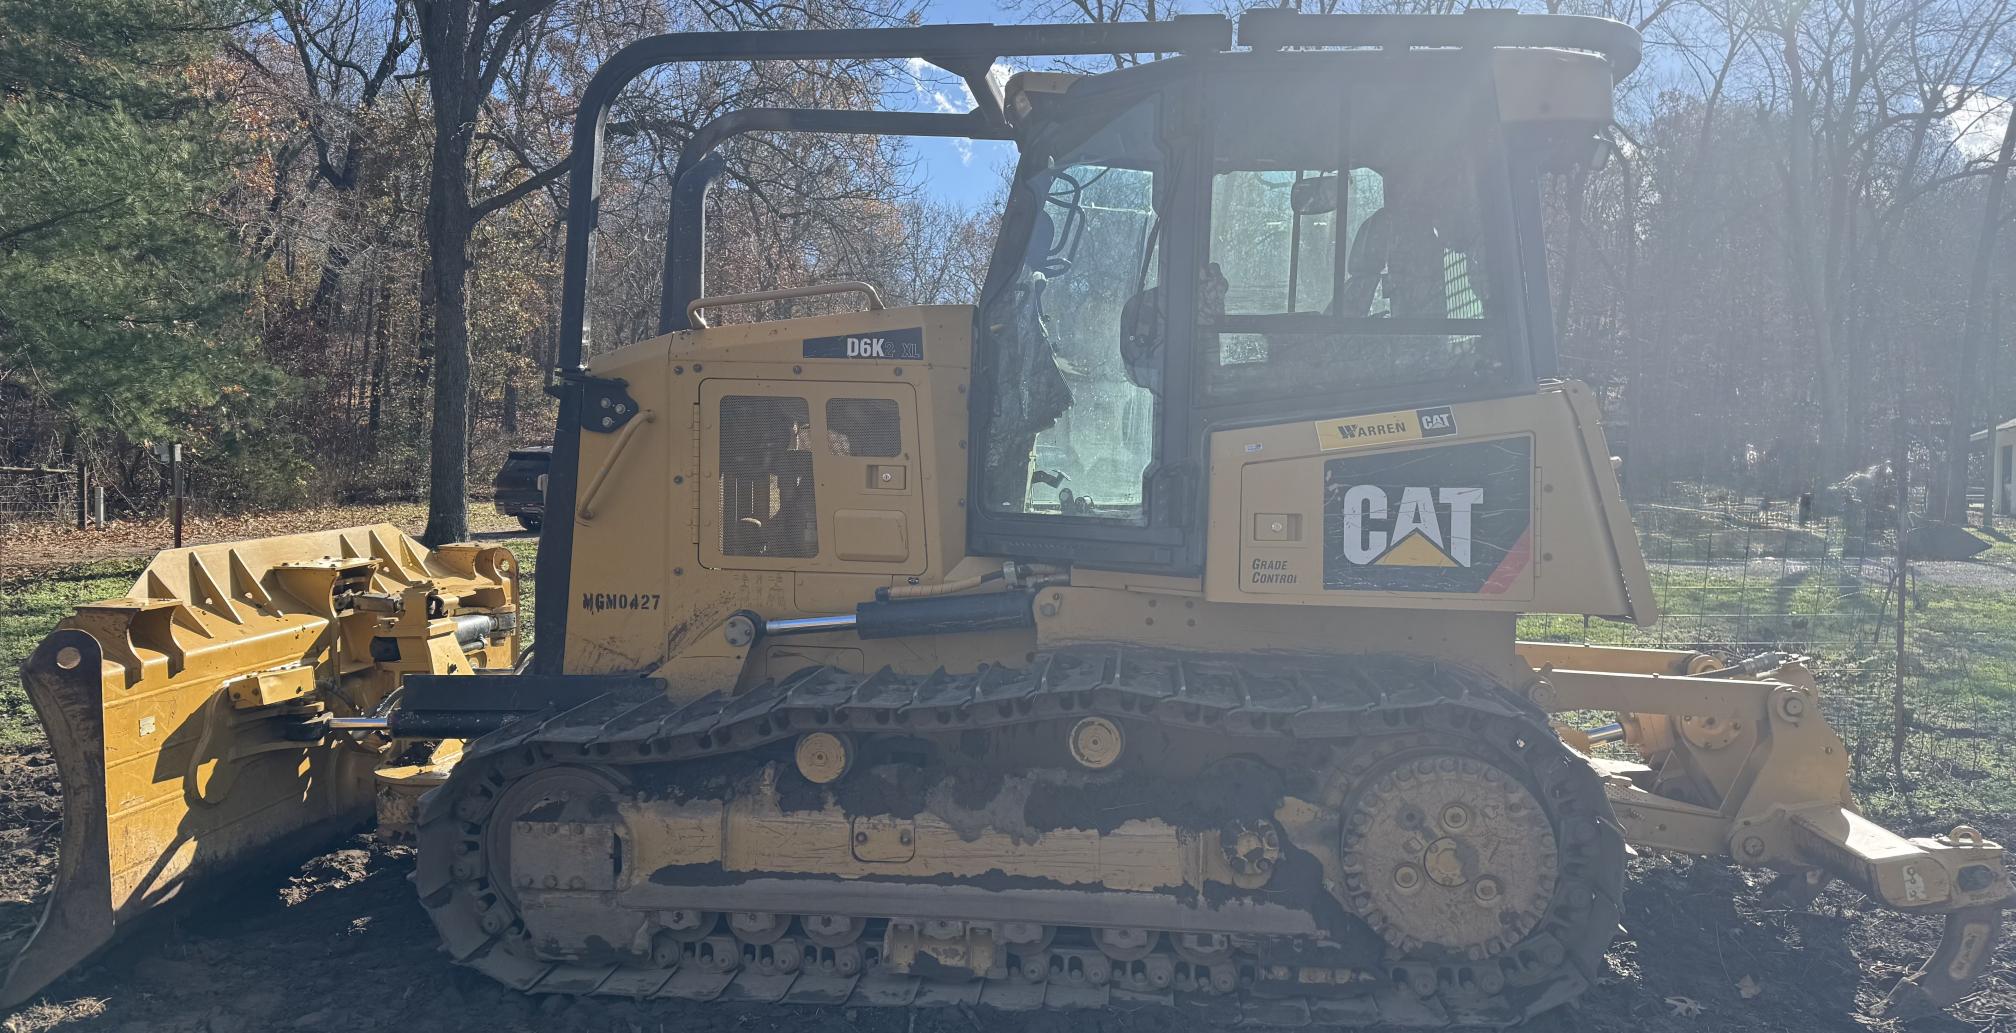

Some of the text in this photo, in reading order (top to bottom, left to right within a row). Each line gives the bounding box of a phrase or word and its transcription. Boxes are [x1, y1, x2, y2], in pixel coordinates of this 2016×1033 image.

[1338, 413, 1450, 439] WARREN CAT
[1343, 484, 1484, 568] CAT
[1252, 558, 1287, 570] GRADE
[582, 593, 661, 611] MGM0427
